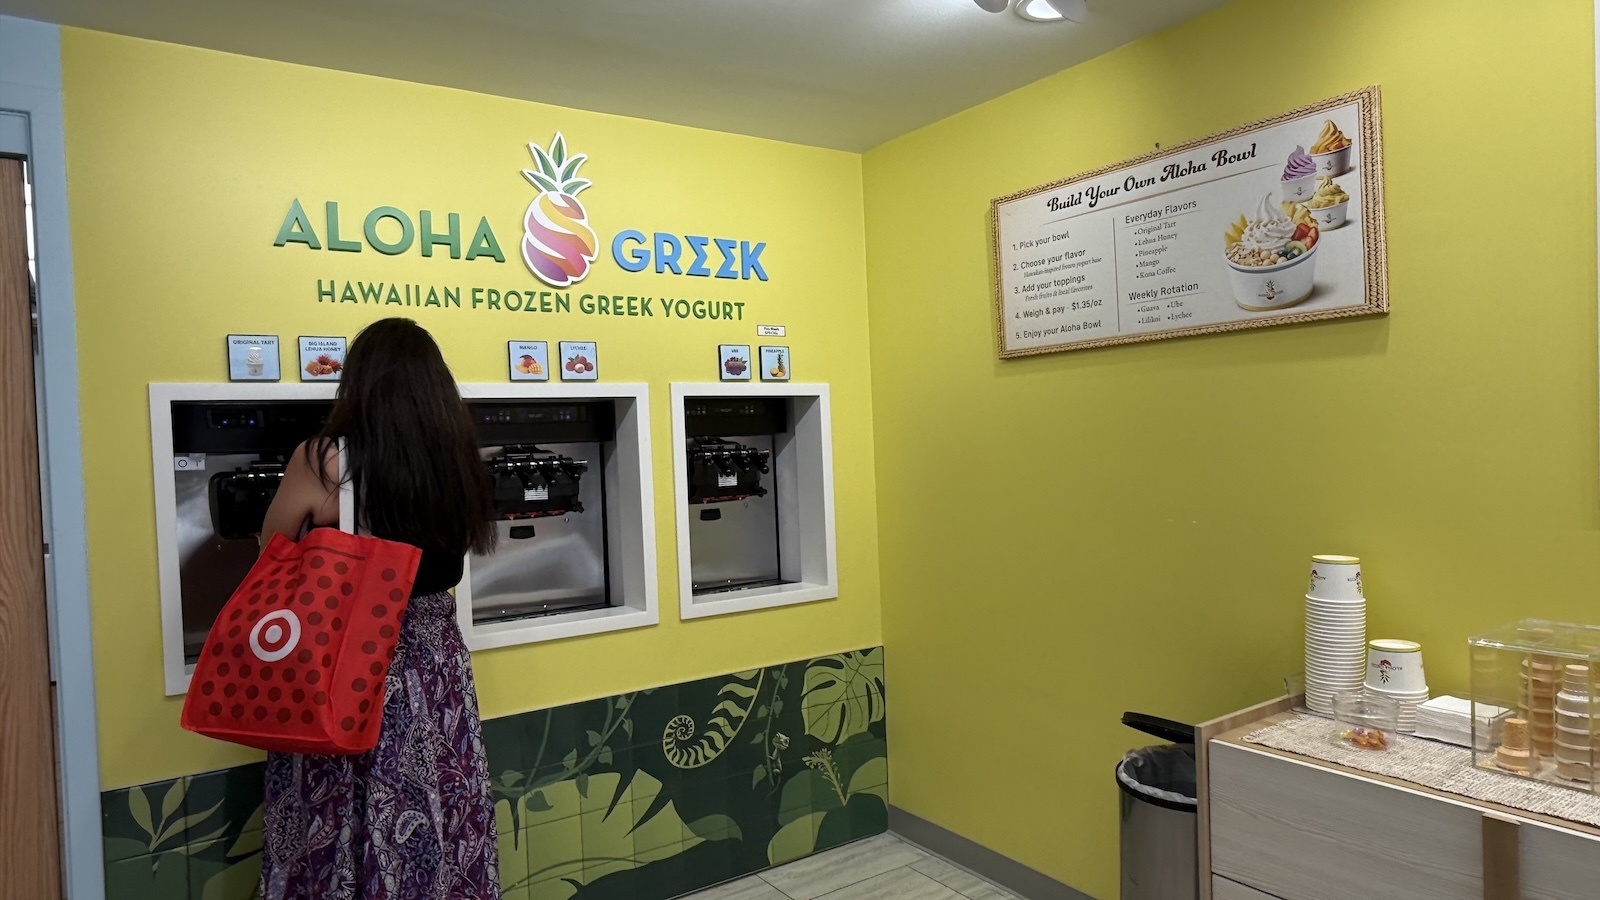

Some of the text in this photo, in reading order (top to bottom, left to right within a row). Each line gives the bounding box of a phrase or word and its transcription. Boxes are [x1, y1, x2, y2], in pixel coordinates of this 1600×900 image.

[1046, 143, 1257, 212] Build Your Own Aloha Bowl
[1125, 200, 1197, 224] Everyday Flavors
[273, 197, 506, 263] ALOHA
[1137, 221, 1176, 235] Original Tart
[1157, 232, 1178, 242] Honey
[1012, 231, 1070, 251] 1. Pick your bowl
[1012, 249, 1086, 271] 2. Choose your flavor
[1138, 245, 1168, 257] Pineapple
[1139, 259, 1160, 268] Mango
[1139, 266, 1177, 279] Kona Coffee
[1014, 274, 1086, 294] 3. Add your toppings
[1025, 293, 1039, 302] Fresh
[1038, 291, 1053, 300] fruits
[1058, 287, 1070, 296] local
[1070, 284, 1093, 294] favorites
[1128, 282, 1199, 301] Weekly Rotation
[317, 279, 745, 321] HAWAIIAN FROZEN GREEK YOGURT
[1014, 312, 1021, 320] 4.
[1022, 308, 1044, 319] Weigh
[1045, 306, 1051, 315] &
[1052, 305, 1065, 315] pay
[1071, 299, 1103, 311] $1.35/oz
[1140, 305, 1160, 313] Guava
[1171, 311, 1193, 321] Lychee
[1015, 319, 1102, 340] 5. Enjoy your Aloha Bowl
